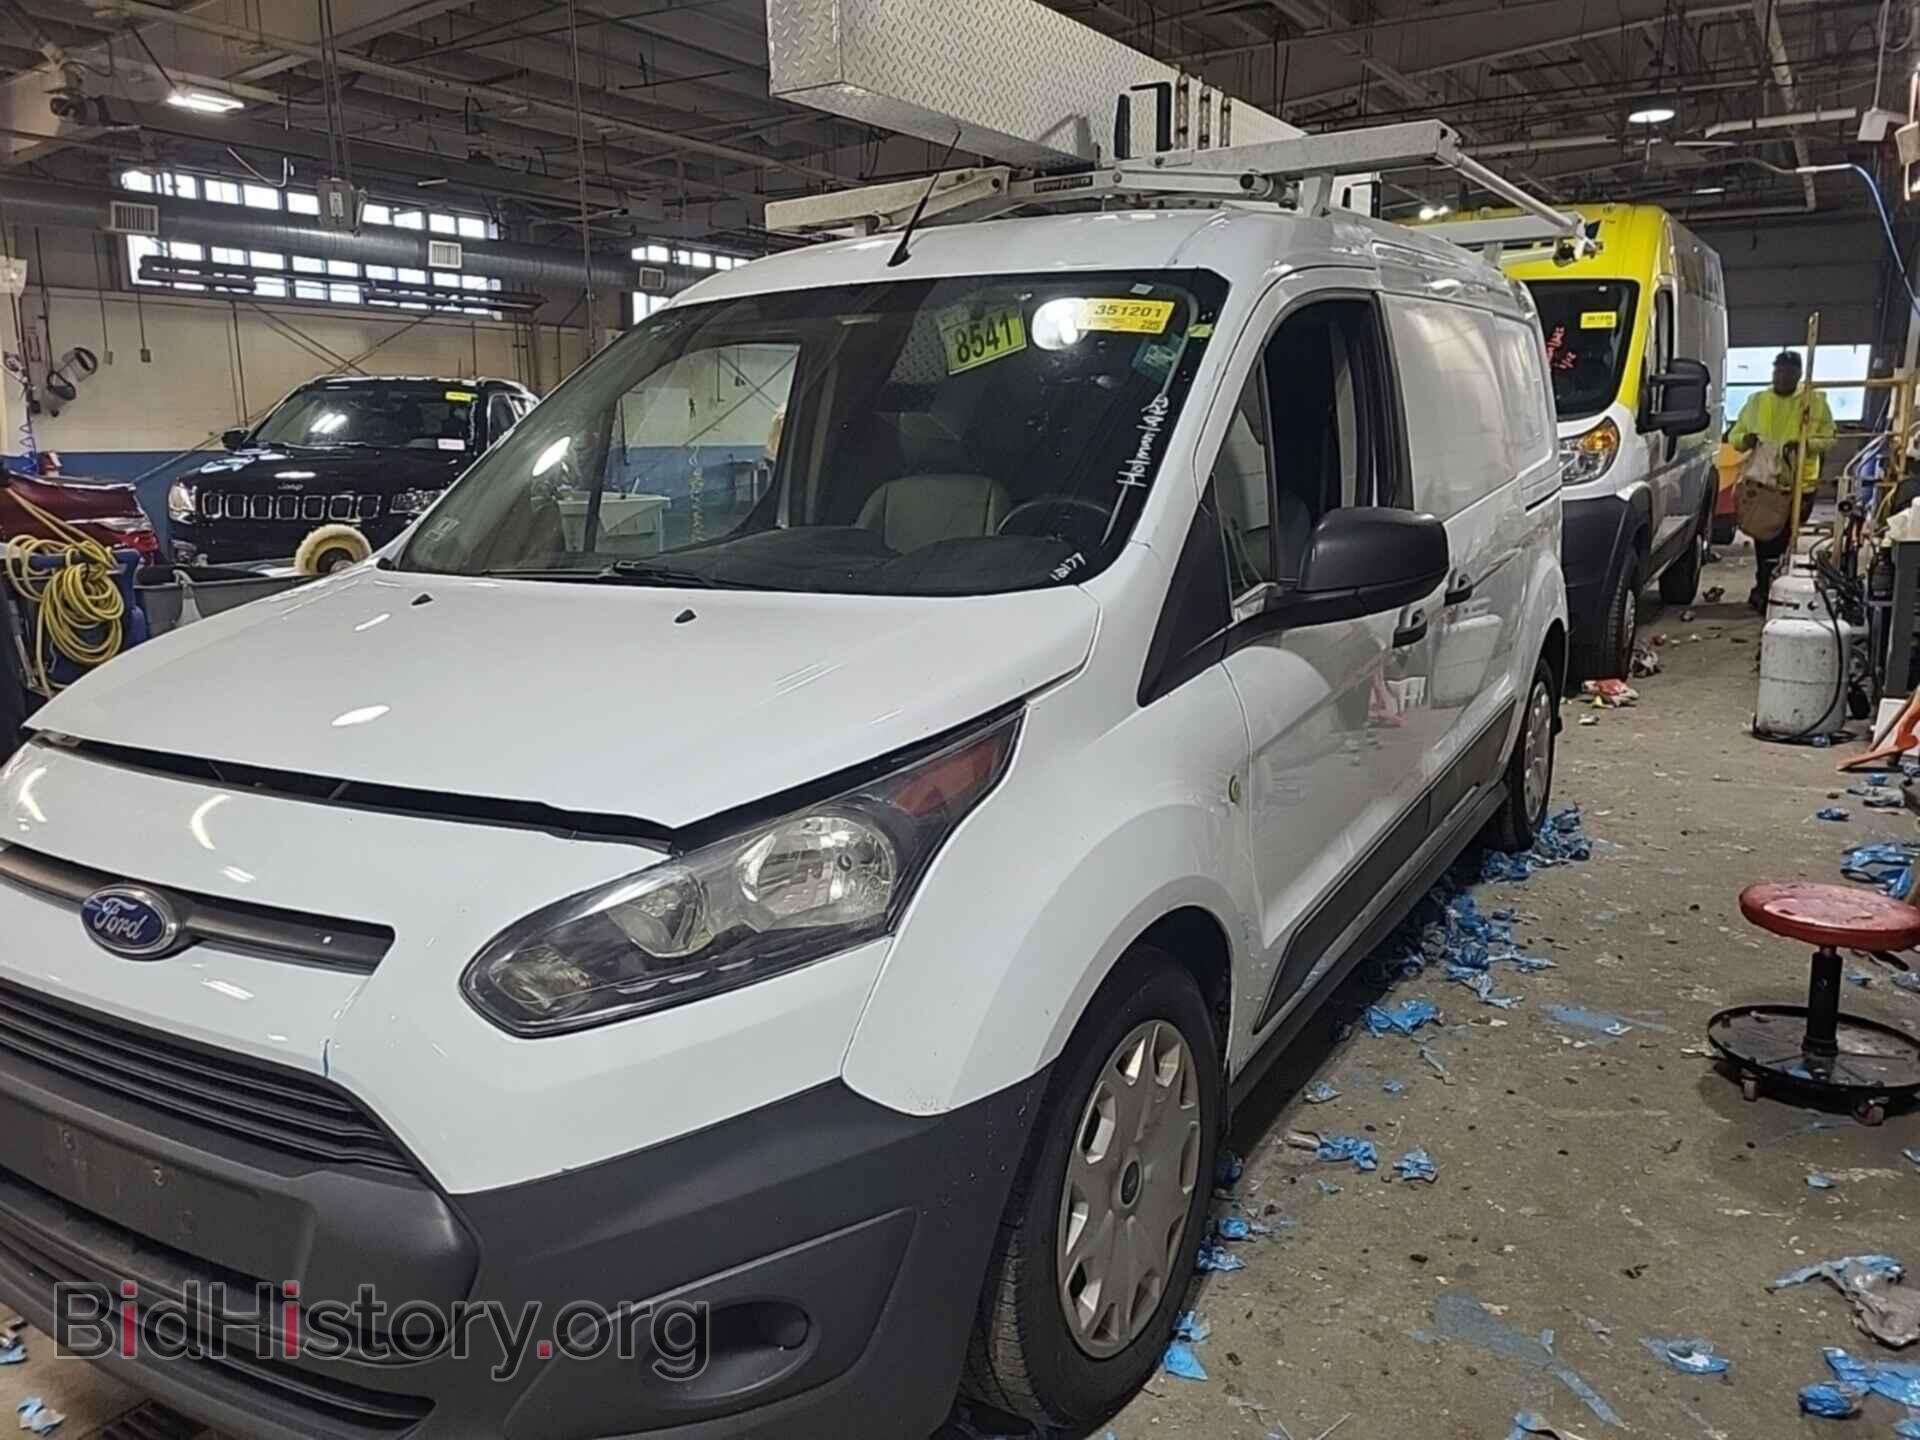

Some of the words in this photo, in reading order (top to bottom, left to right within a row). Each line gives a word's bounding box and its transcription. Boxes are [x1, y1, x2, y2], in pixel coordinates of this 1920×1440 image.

[1094, 304, 1162, 318] 351201
[954, 312, 1013, 363] 8541
[94, 897, 149, 940] Ford
